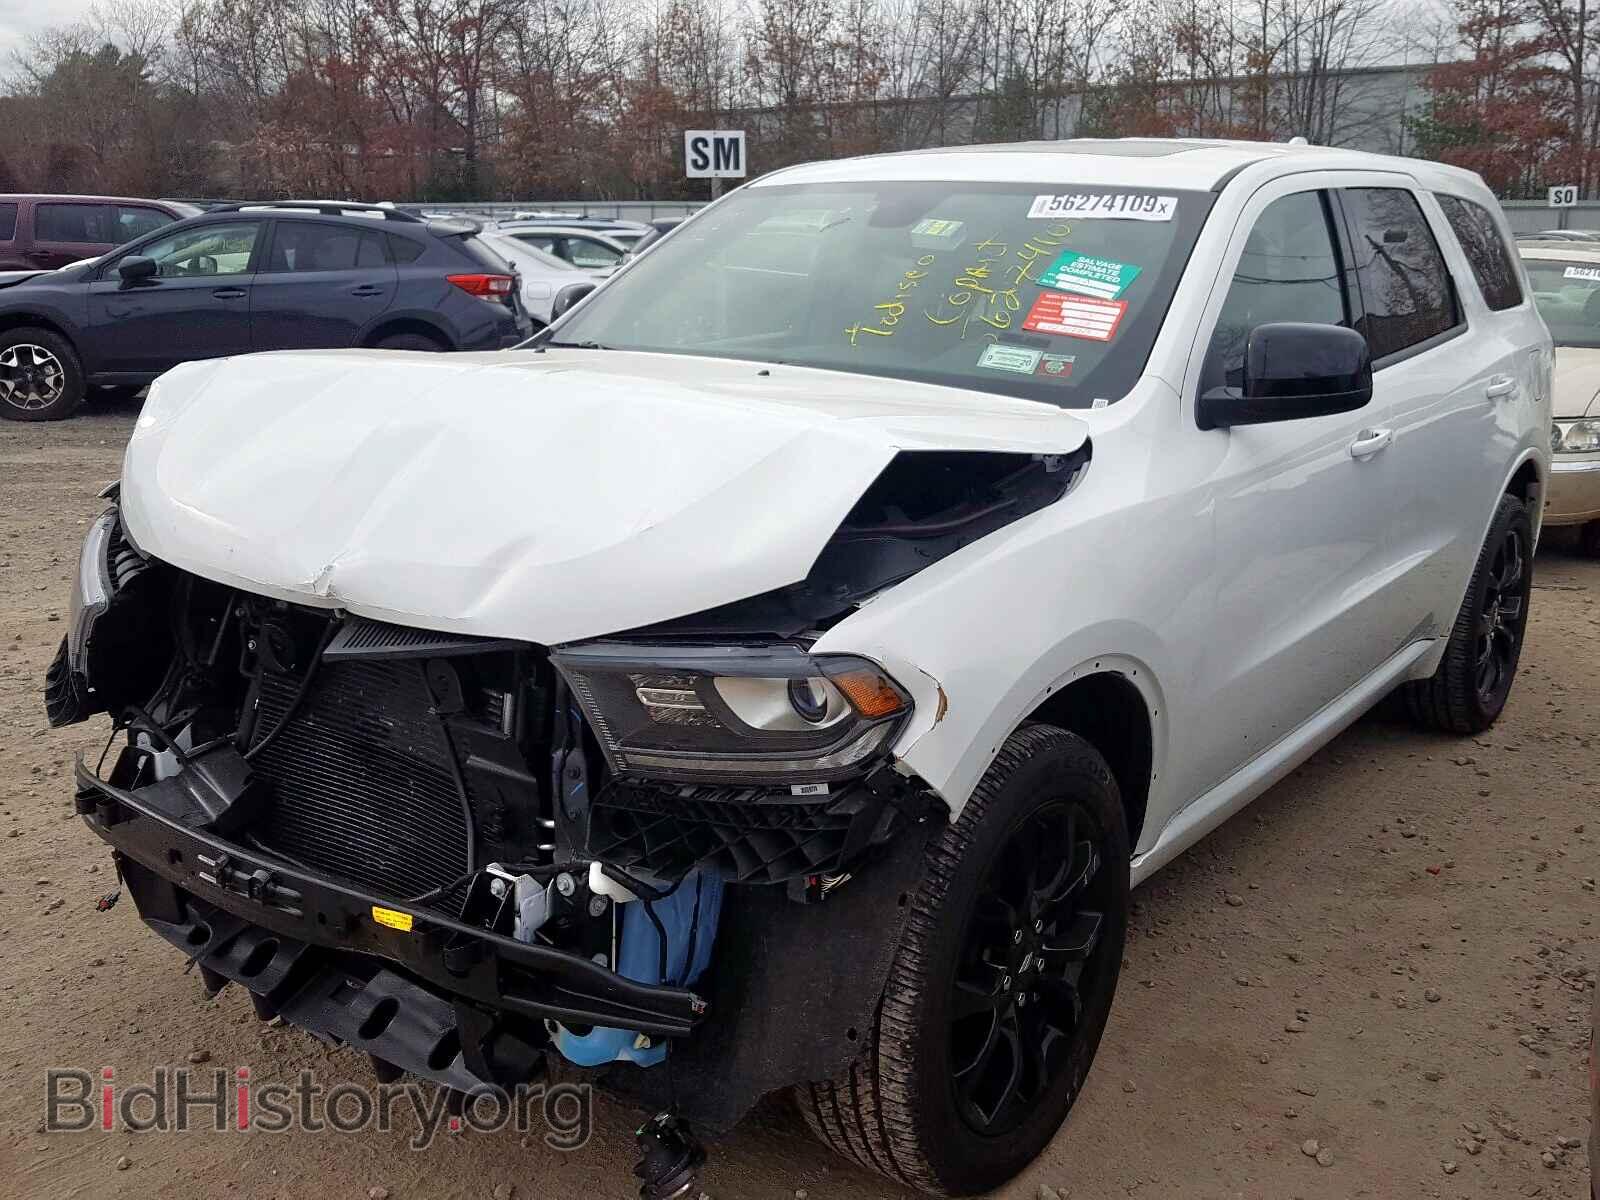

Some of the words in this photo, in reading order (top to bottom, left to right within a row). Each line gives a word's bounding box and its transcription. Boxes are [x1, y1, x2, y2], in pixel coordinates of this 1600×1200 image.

[690, 137, 740, 171] SM
[1553, 190, 1574, 204] SO
[1070, 261, 1121, 276] ESTIMATE
[1077, 256, 1122, 270] SALVAGE
[1060, 265, 1121, 283] COMPLETED
